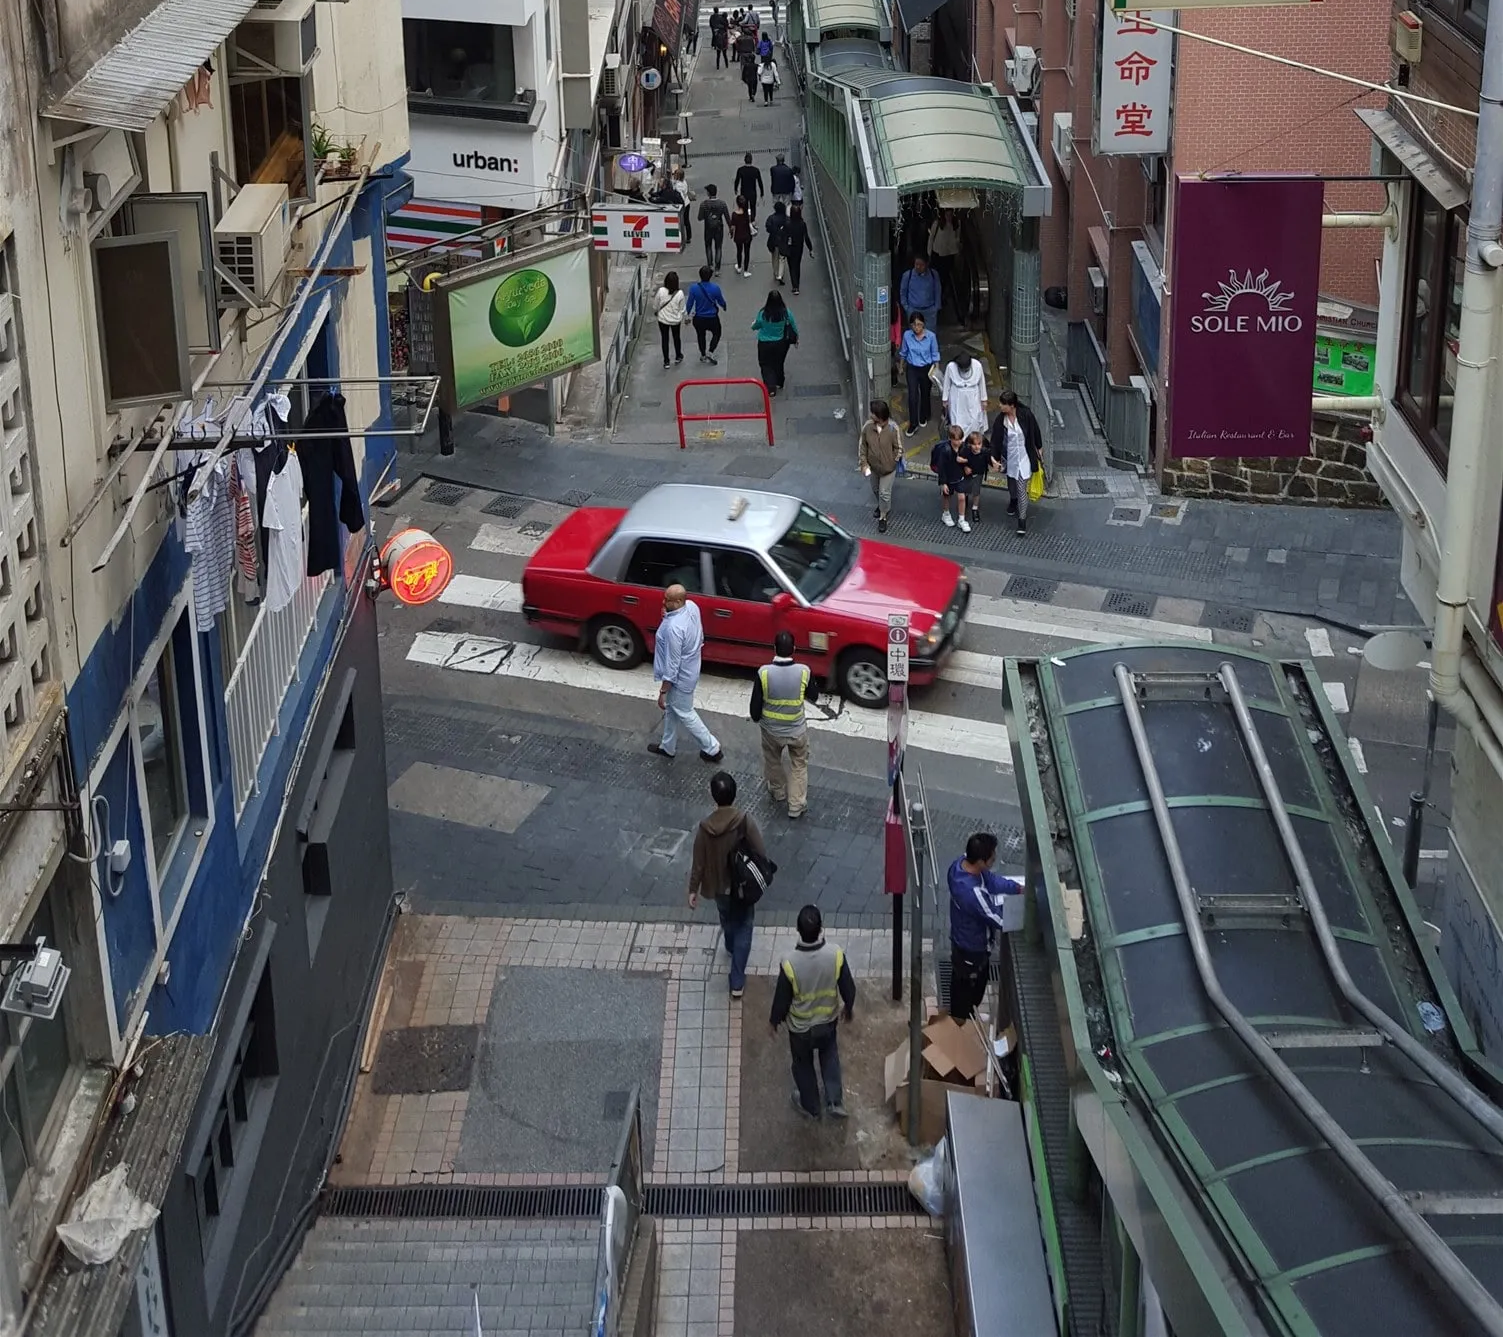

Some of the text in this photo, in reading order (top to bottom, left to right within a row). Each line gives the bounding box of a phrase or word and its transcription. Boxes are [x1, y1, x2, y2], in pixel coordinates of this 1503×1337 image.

[1191, 315, 1303, 333] SOLE MIO
[1187, 429, 1217, 440] Italian
[1220, 429, 1265, 440] Restaurant
[1278, 429, 1295, 439] Bar
[890, 648, 906, 677] 中環
